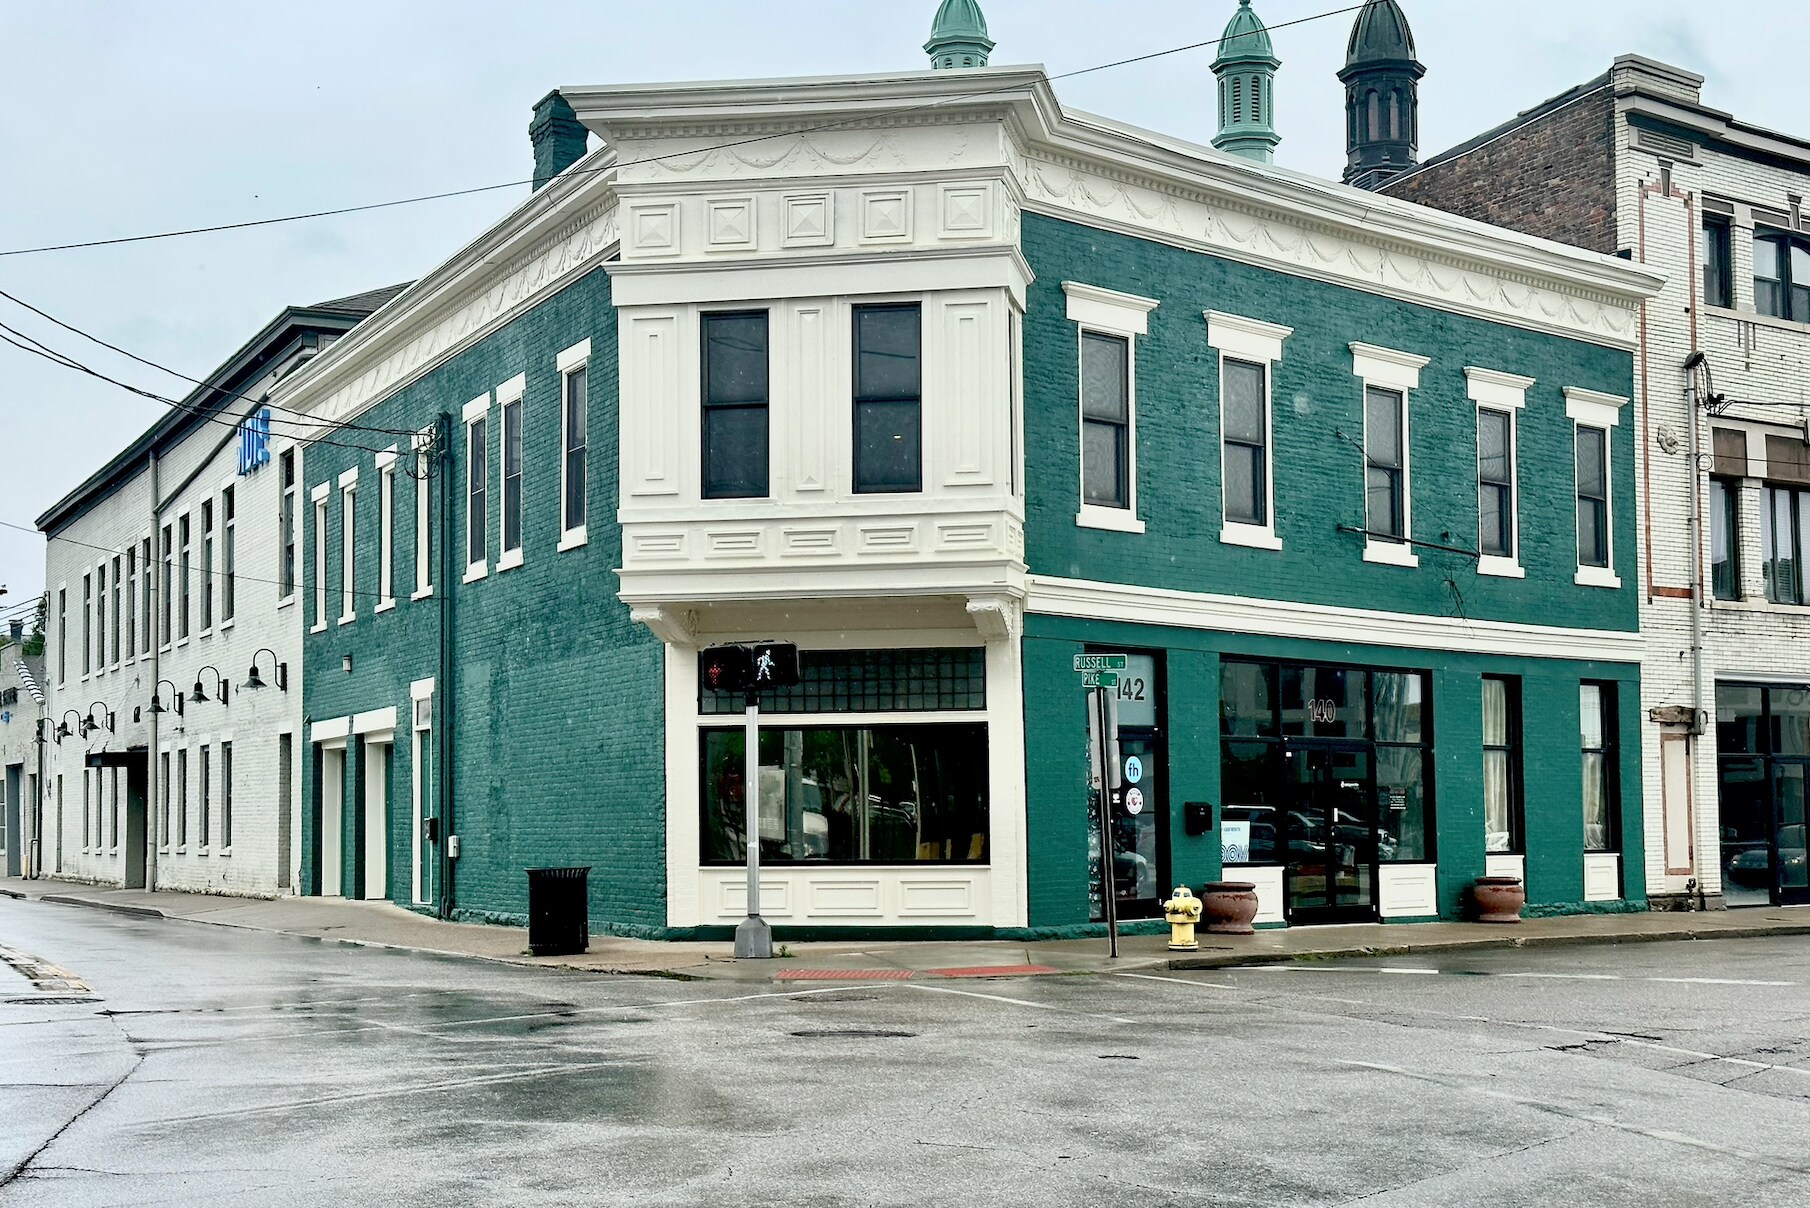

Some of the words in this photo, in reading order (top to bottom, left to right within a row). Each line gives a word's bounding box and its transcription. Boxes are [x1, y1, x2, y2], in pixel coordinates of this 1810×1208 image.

[1074, 656, 1111, 669] RUSSELL
[1083, 672, 1100, 685] PIKE
[1117, 677, 1145, 701] 142
[1308, 698, 1336, 723] 140
[1128, 762, 1139, 778] fh
